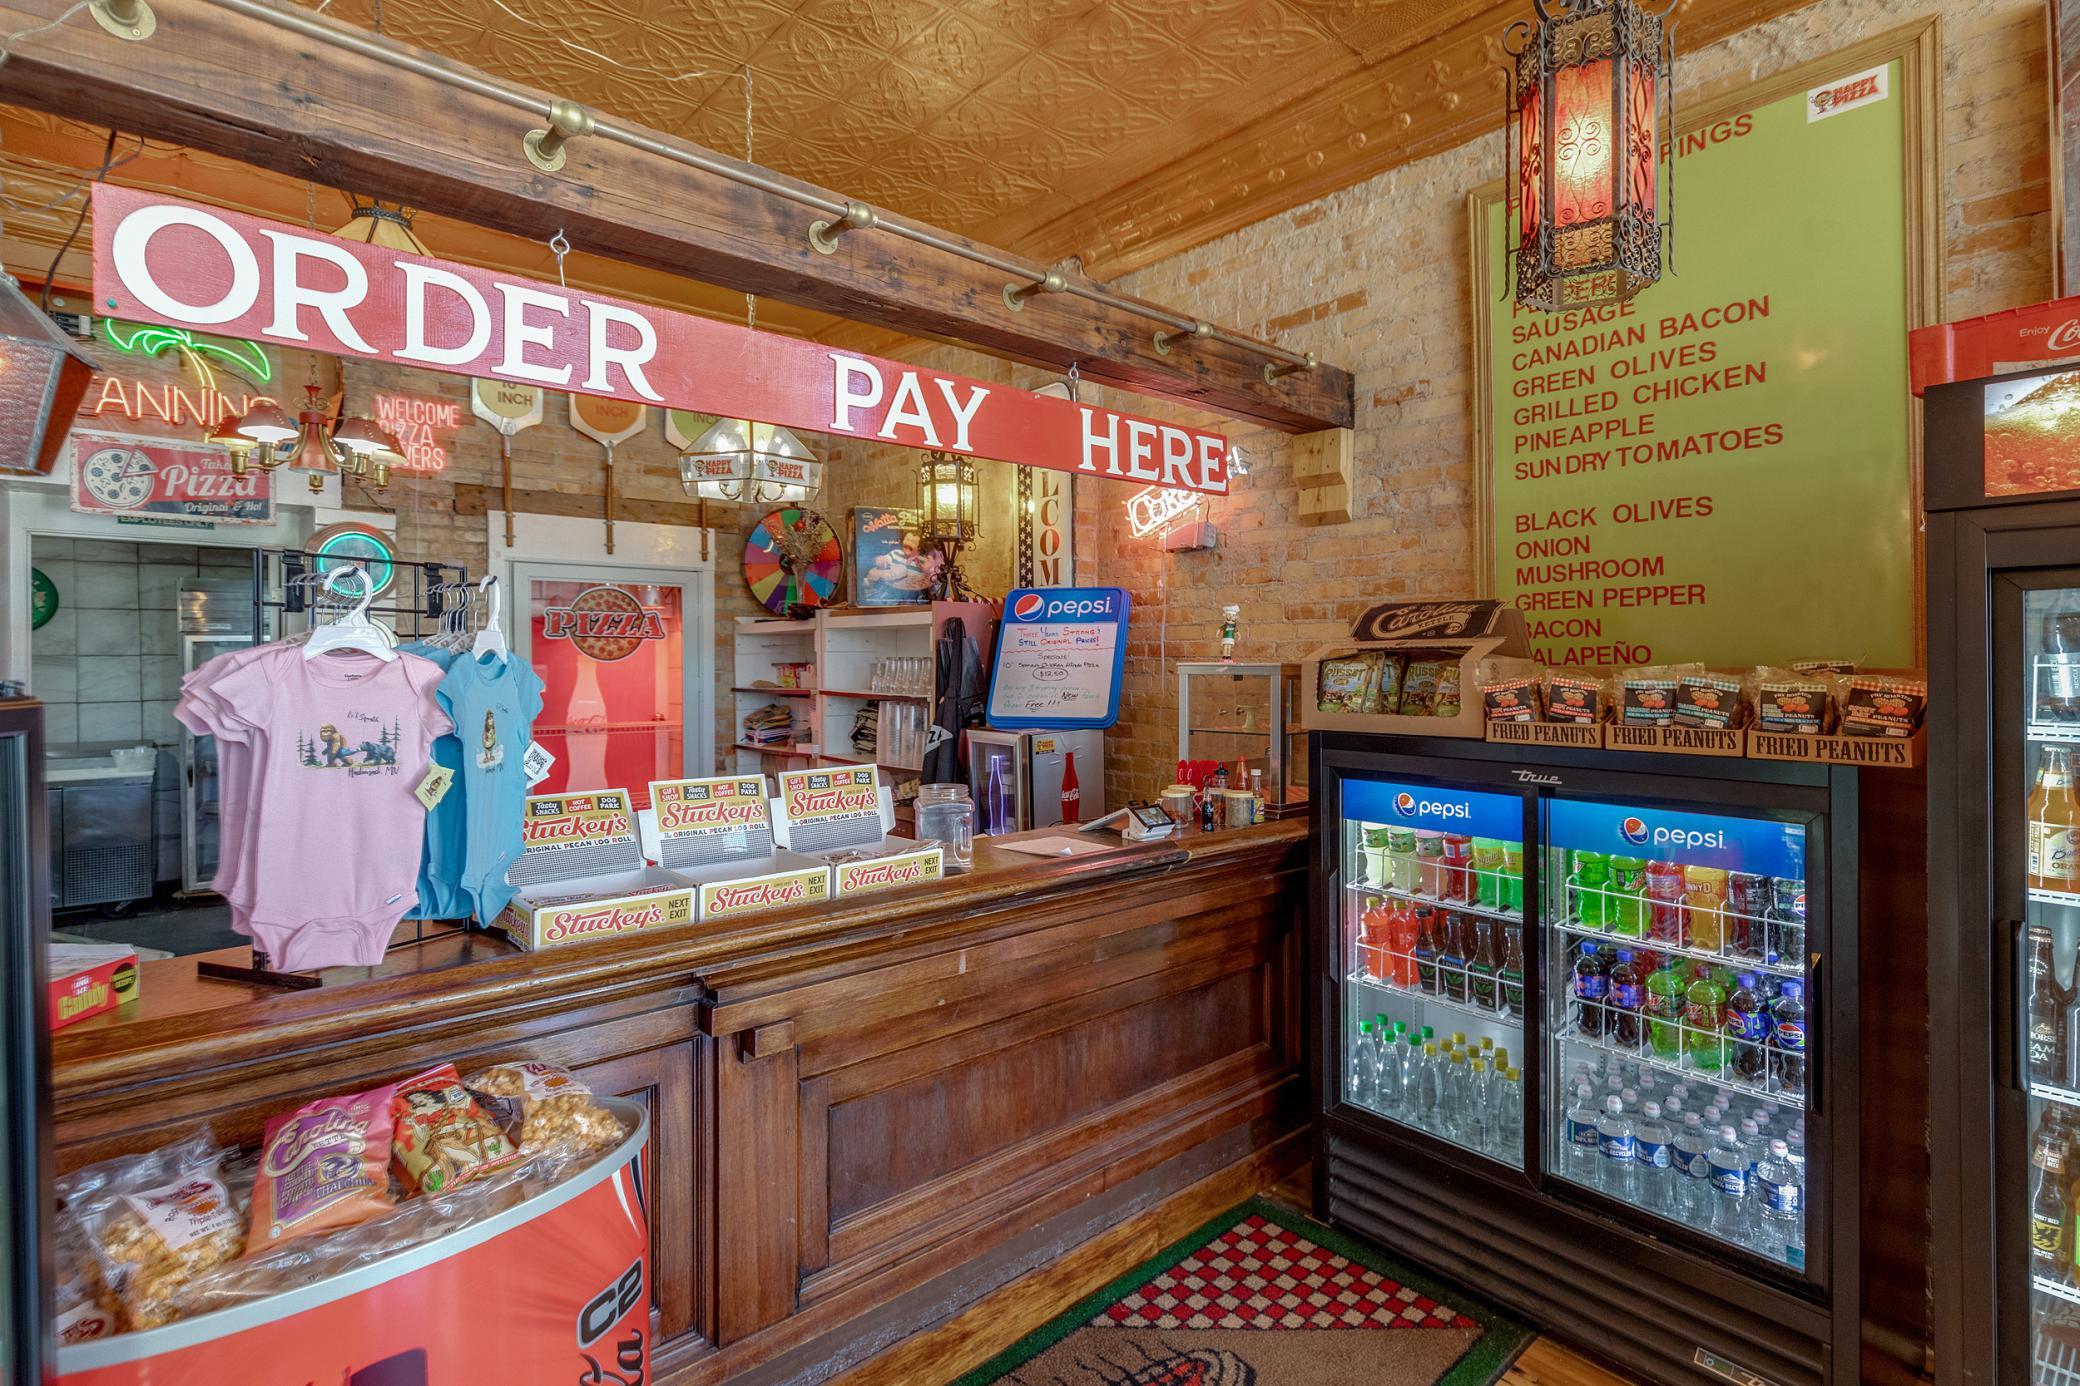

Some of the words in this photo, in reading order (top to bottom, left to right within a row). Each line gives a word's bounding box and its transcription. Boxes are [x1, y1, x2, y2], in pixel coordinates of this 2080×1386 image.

[1832, 74, 1878, 95] HAPPY
[1832, 84, 1879, 107] PIZZA
[1659, 113, 1753, 166] PINGS
[1512, 301, 1636, 345] SAUSAGE
[1512, 323, 1646, 372] CANADIAN
[1659, 295, 1771, 339] BACON
[2019, 326, 2051, 337] Enjoy
[112, 204, 666, 402] ORDER
[828, 353, 991, 453] PAY
[1078, 407, 1228, 492] HERE
[1512, 365, 1595, 398] GREEN
[1610, 340, 1718, 379] OLIVES
[94, 377, 280, 426] ANNIN
[497, 392, 534, 407] INCH
[1513, 391, 1619, 426] GRILLED
[1633, 361, 1767, 405] CHICKEN
[377, 397, 461, 429] WELCOME
[595, 399, 629, 417] INCH
[693, 412, 722, 425] INC
[1514, 413, 1656, 454] PINEAPPLE
[704, 459, 733, 467] HAPPY
[704, 466, 734, 476] PIZZA
[778, 462, 804, 472] HAPPY
[160, 463, 257, 497] Pizza
[778, 468, 804, 480] PIZZA
[1515, 507, 1597, 533] BLACK
[1612, 495, 1714, 524] OLIVES
[1515, 535, 1591, 560] ONION
[1516, 556, 1665, 586] MUSHROOM
[1047, 596, 1112, 618] pepsi
[1515, 589, 1594, 612] GREEN
[1602, 583, 1706, 608] PEPPER
[1532, 640, 1653, 667] ALAPEÑO
[1492, 723, 1530, 741] FRIED
[1534, 725, 1596, 744] PEANUTS
[1613, 727, 1657, 746] FRIED
[1662, 729, 1737, 750] PEANUTS
[1756, 735, 1809, 757] FRIED
[1815, 739, 1906, 764] PEANUTS
[714, 789, 734, 797] COFFEE
[810, 781, 828, 789] SNACKS
[535, 801, 558, 810] Tasty
[686, 792, 708, 800] SNACKS
[789, 788, 875, 817] Stuckey's
[534, 807, 561, 816] SNACKS
[568, 803, 593, 812] COFFEE
[661, 799, 763, 829] Stuckey's
[799, 816, 829, 825] ORIGINAL
[863, 809, 878, 817] ROLL
[1418, 800, 1470, 819] pepsi
[673, 829, 708, 838] ORIGINAL
[709, 826, 733, 834] PECAN
[749, 822, 766, 830] ROLL
[1653, 826, 1724, 849] pepsi
[527, 843, 568, 854] RIGINAL
[563, 840, 593, 849] PECAN
[594, 838, 611, 846] LOG
[612, 836, 632, 844] ROLL
[924, 857, 939, 866] NEXT
[925, 865, 938, 875] EXIT
[2051, 861, 2080, 870] ORAN
[808, 875, 826, 885] NEXT
[843, 859, 920, 890] Stuckey's
[710, 879, 804, 912] Stuckey's
[809, 884, 824, 894] EXIT
[668, 897, 690, 910] NEXT
[669, 908, 687, 920] EXIT
[545, 903, 661, 941] Stuckey's
